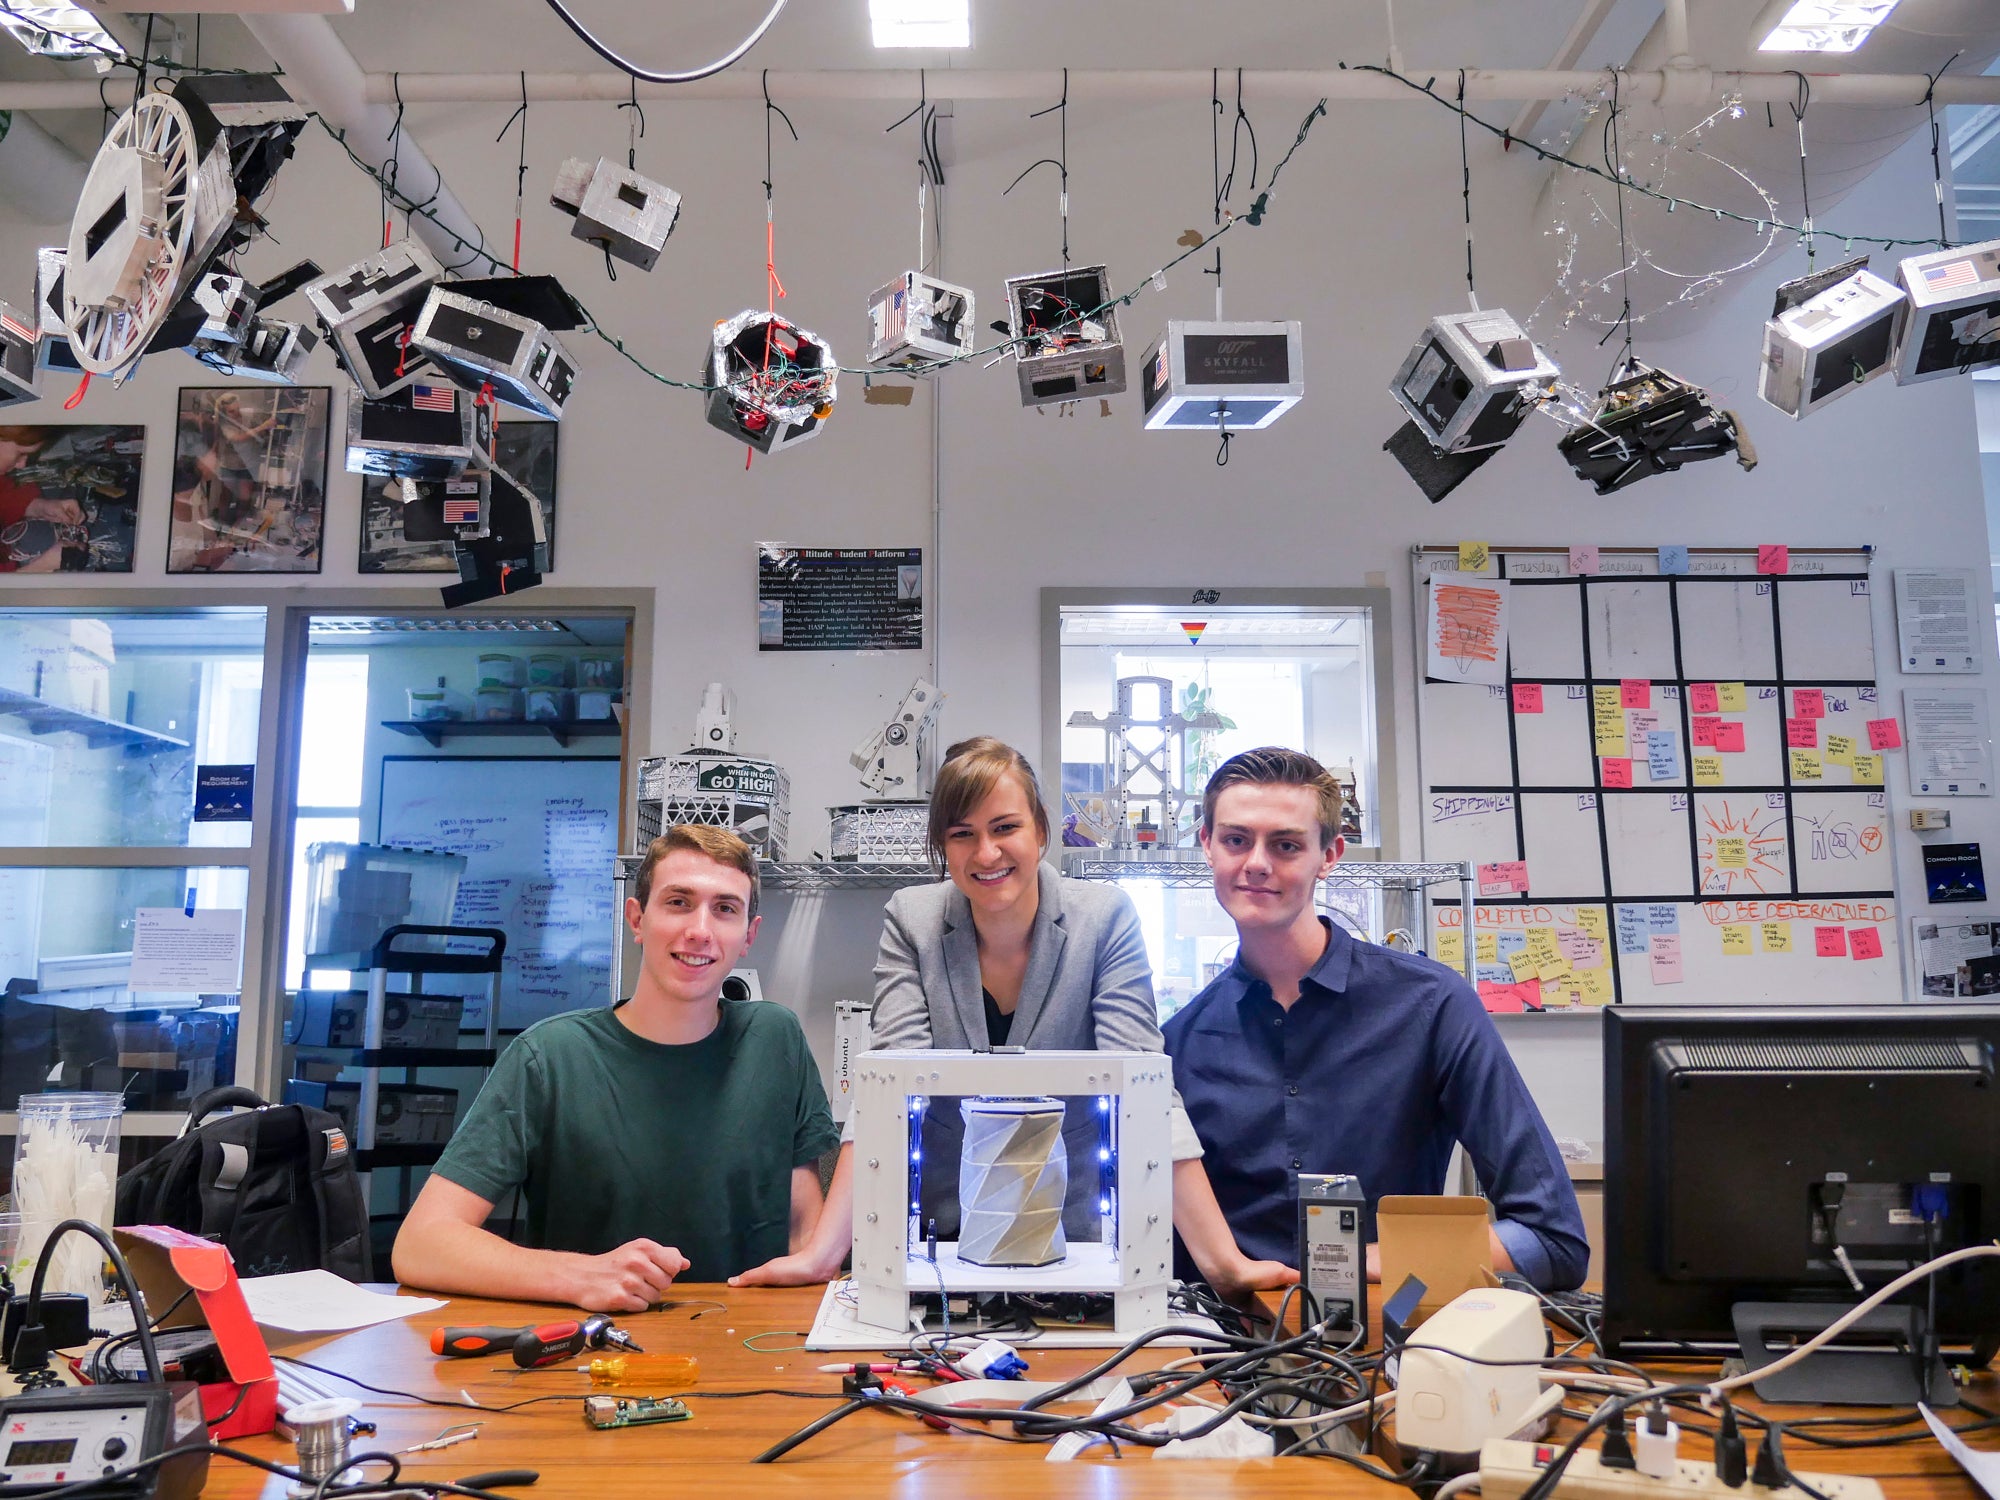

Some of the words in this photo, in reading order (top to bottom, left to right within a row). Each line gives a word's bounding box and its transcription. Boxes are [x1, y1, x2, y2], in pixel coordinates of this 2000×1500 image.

[1217, 341, 1257, 354] 007
[1204, 357, 1266, 367] SKYFALL
[801, 549, 833, 558] Altitude
[834, 549, 867, 558] Student
[868, 549, 905, 558] Platform
[1571, 551, 1590, 570] EPS
[1599, 561, 1643, 573] ednesday
[1853, 581, 1867, 593] 14
[728, 769, 749, 777] WHEN
[710, 775, 736, 789] GO
[738, 777, 774, 793] HIGH
[1580, 794, 1595, 806] 25
[1672, 794, 1687, 806] 26
[1769, 793, 1785, 805] 27
[1432, 795, 1496, 818] SHIPPING
[1438, 906, 1553, 926] COPLETED
[1706, 901, 1731, 921] TO
[1735, 901, 1761, 918] BE
[1766, 902, 1888, 921] DETERMINED
[841, 1037, 849, 1077] ubuntu
